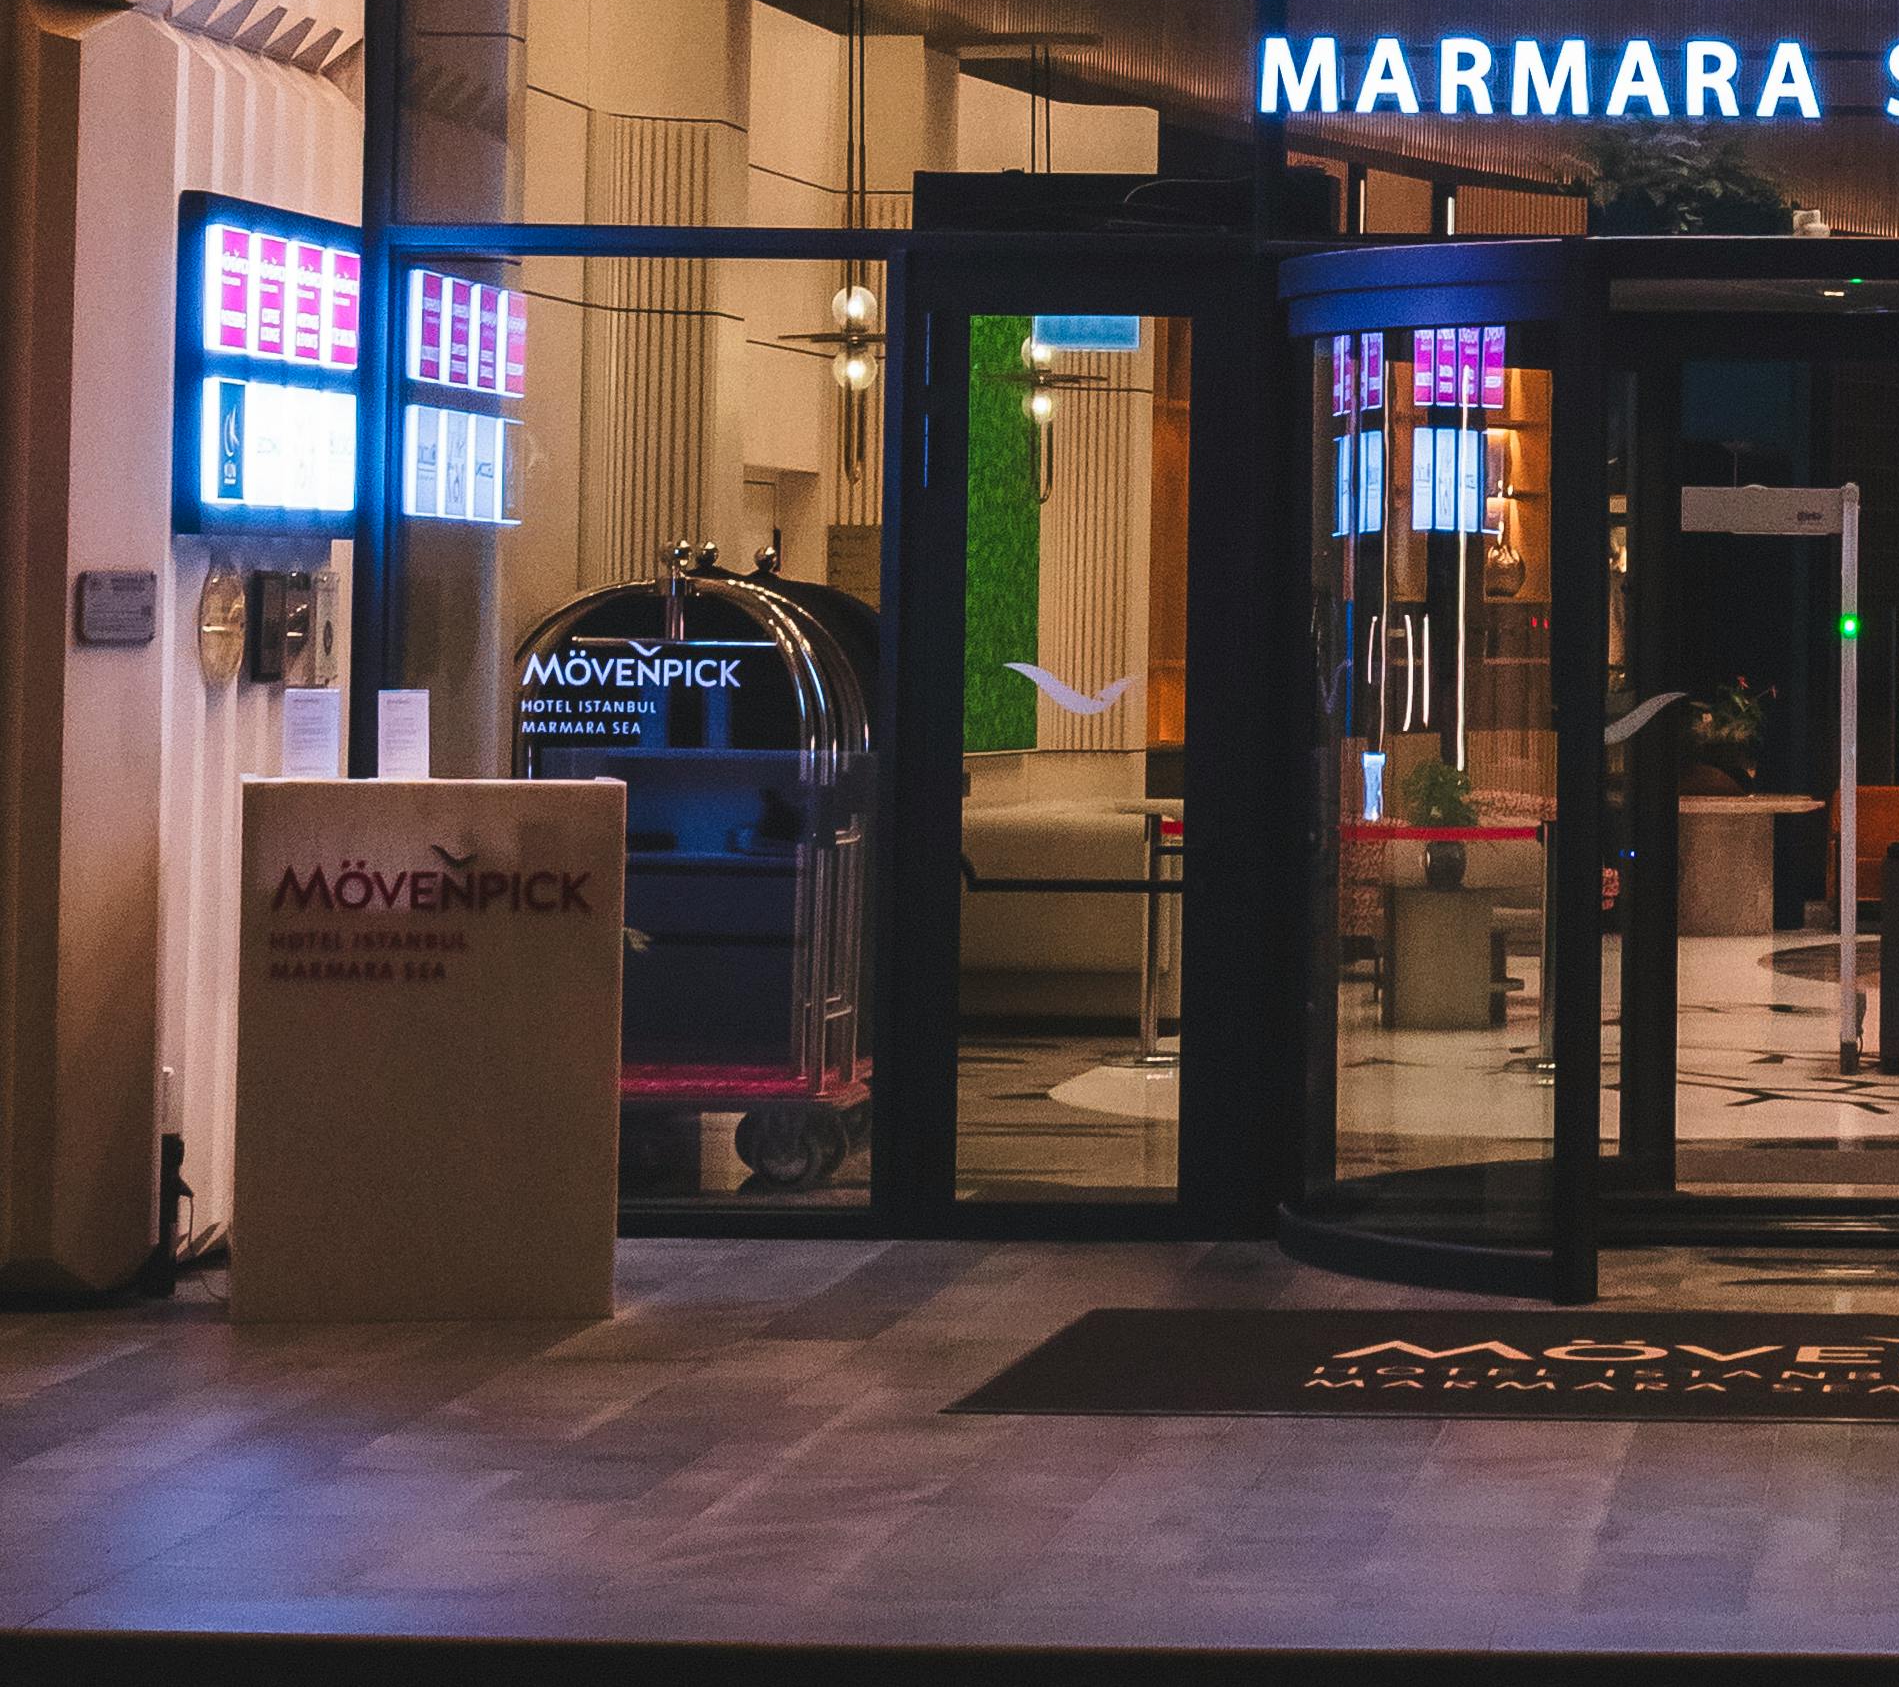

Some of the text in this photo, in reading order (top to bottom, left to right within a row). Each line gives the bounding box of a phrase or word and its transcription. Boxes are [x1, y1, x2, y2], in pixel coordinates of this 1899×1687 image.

[1260, 36, 1822, 119] MARMARA
[522, 649, 741, 687] MÖVENPICK
[521, 699, 657, 714] HOTEL ISTANBUL
[521, 721, 641, 735] MARMARA SEA
[271, 859, 593, 913] MÖVENPICK
[1304, 1379, 1727, 1393] MARMARA
